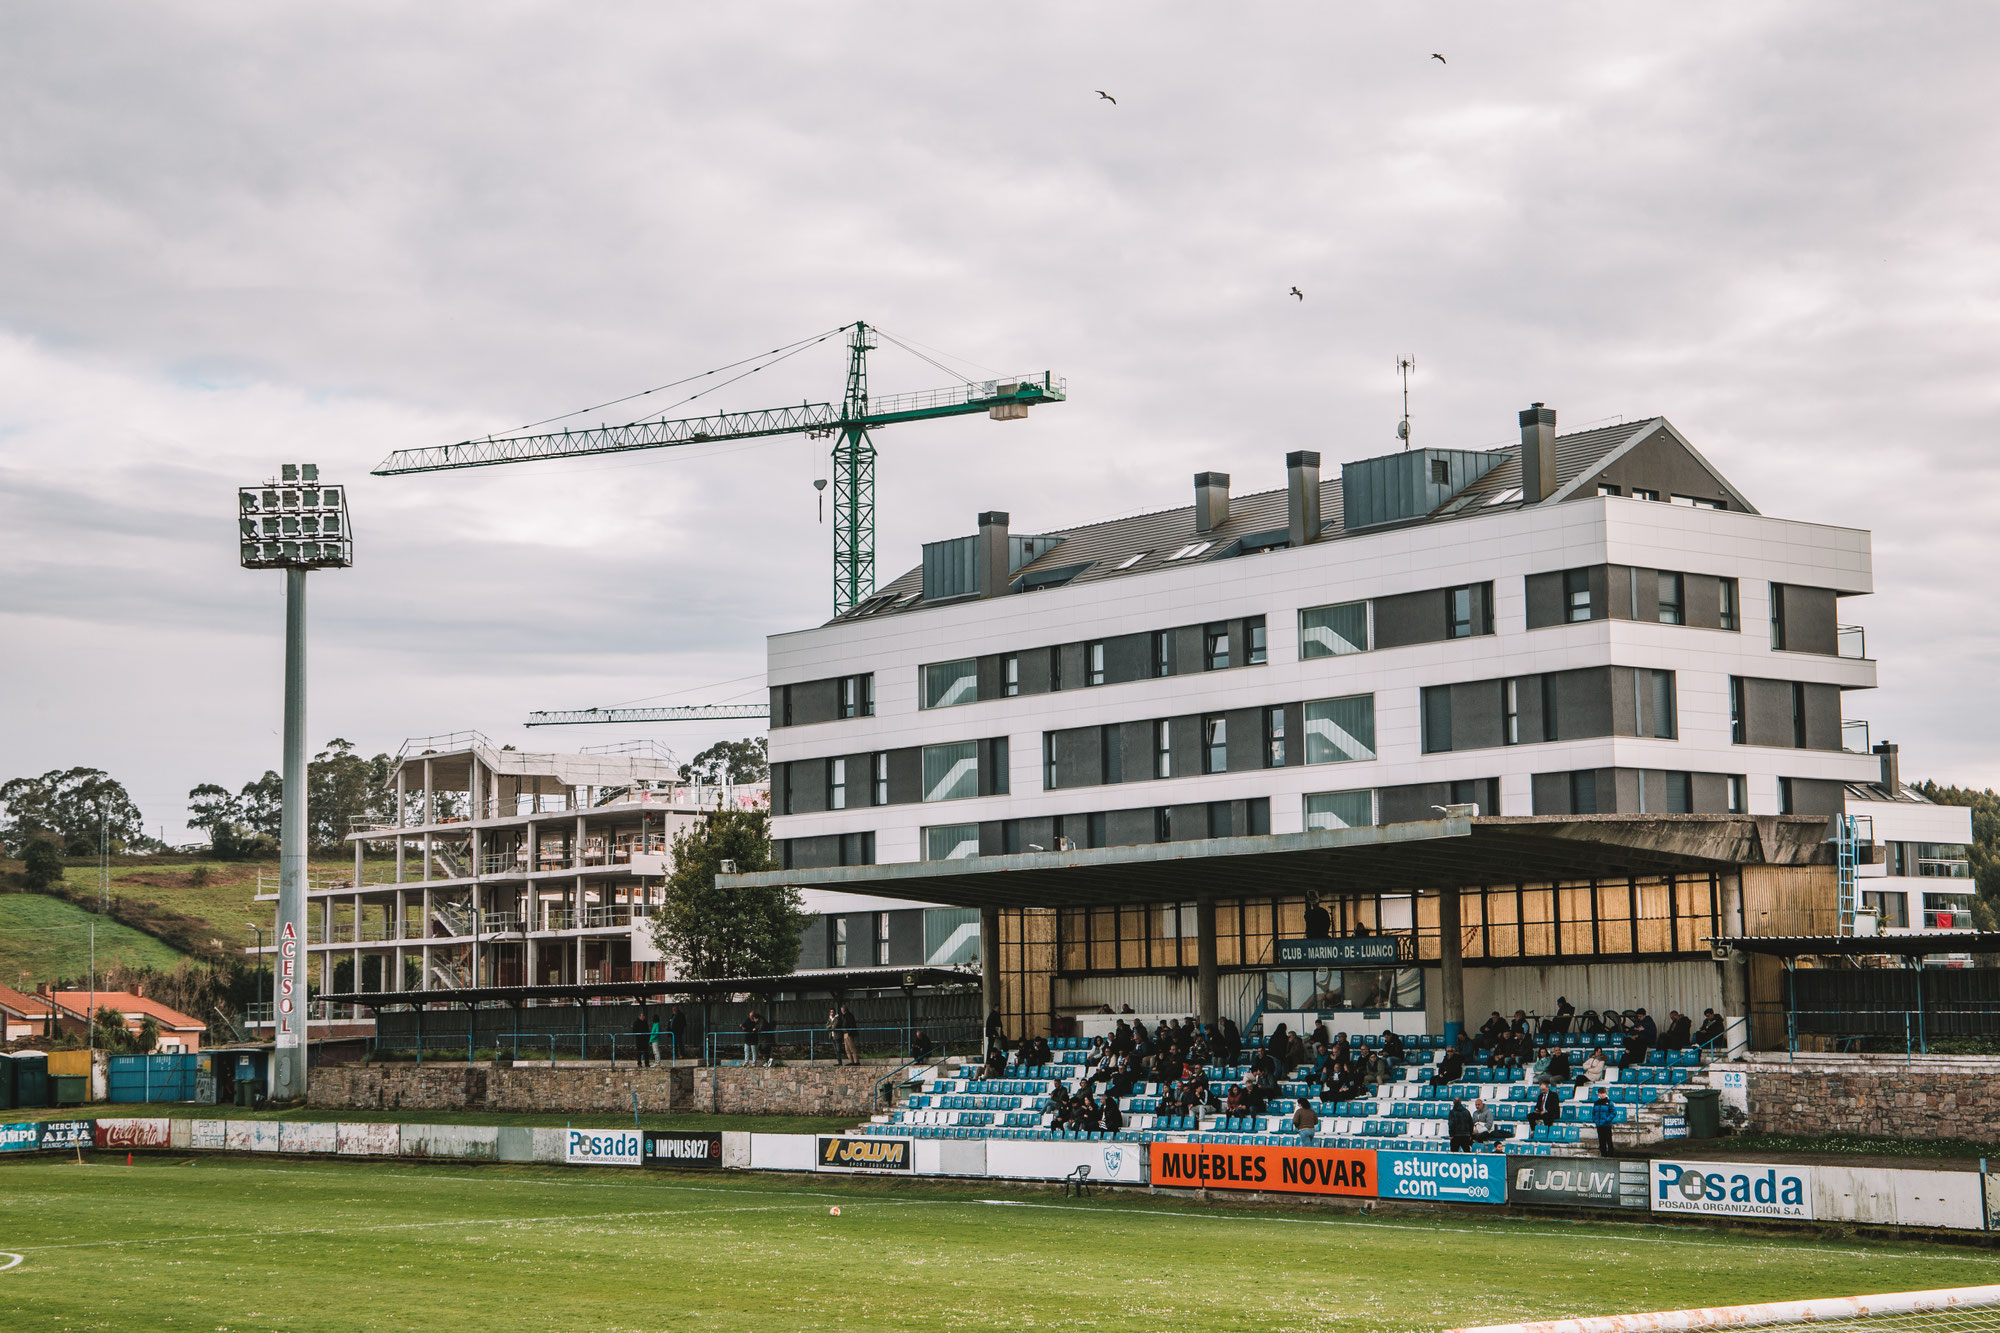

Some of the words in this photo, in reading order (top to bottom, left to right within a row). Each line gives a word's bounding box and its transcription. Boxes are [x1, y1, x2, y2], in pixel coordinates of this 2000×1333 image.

[1282, 947, 1302, 960] CLUB
[1308, 946, 1338, 959] MARINO
[1344, 945, 1355, 958] DE
[1361, 945, 1393, 958] LUANCO
[280, 922, 297, 1033] ACESOL
[0, 1129, 36, 1144] AMPO
[570, 1131, 638, 1156] Posada
[656, 1139, 709, 1158] IMPULSO27
[1162, 1153, 1267, 1182] MUEBLES
[1283, 1158, 1367, 1188] NOVAR
[1393, 1157, 1489, 1183] asturcopia
[1394, 1179, 1437, 1196] .com
[1658, 1163, 1804, 1205] Posada
[1658, 1200, 1700, 1210] POSADA
[1703, 1202, 1781, 1214] ORGANIZACIÓN
[1784, 1206, 1805, 1216] S.A.
